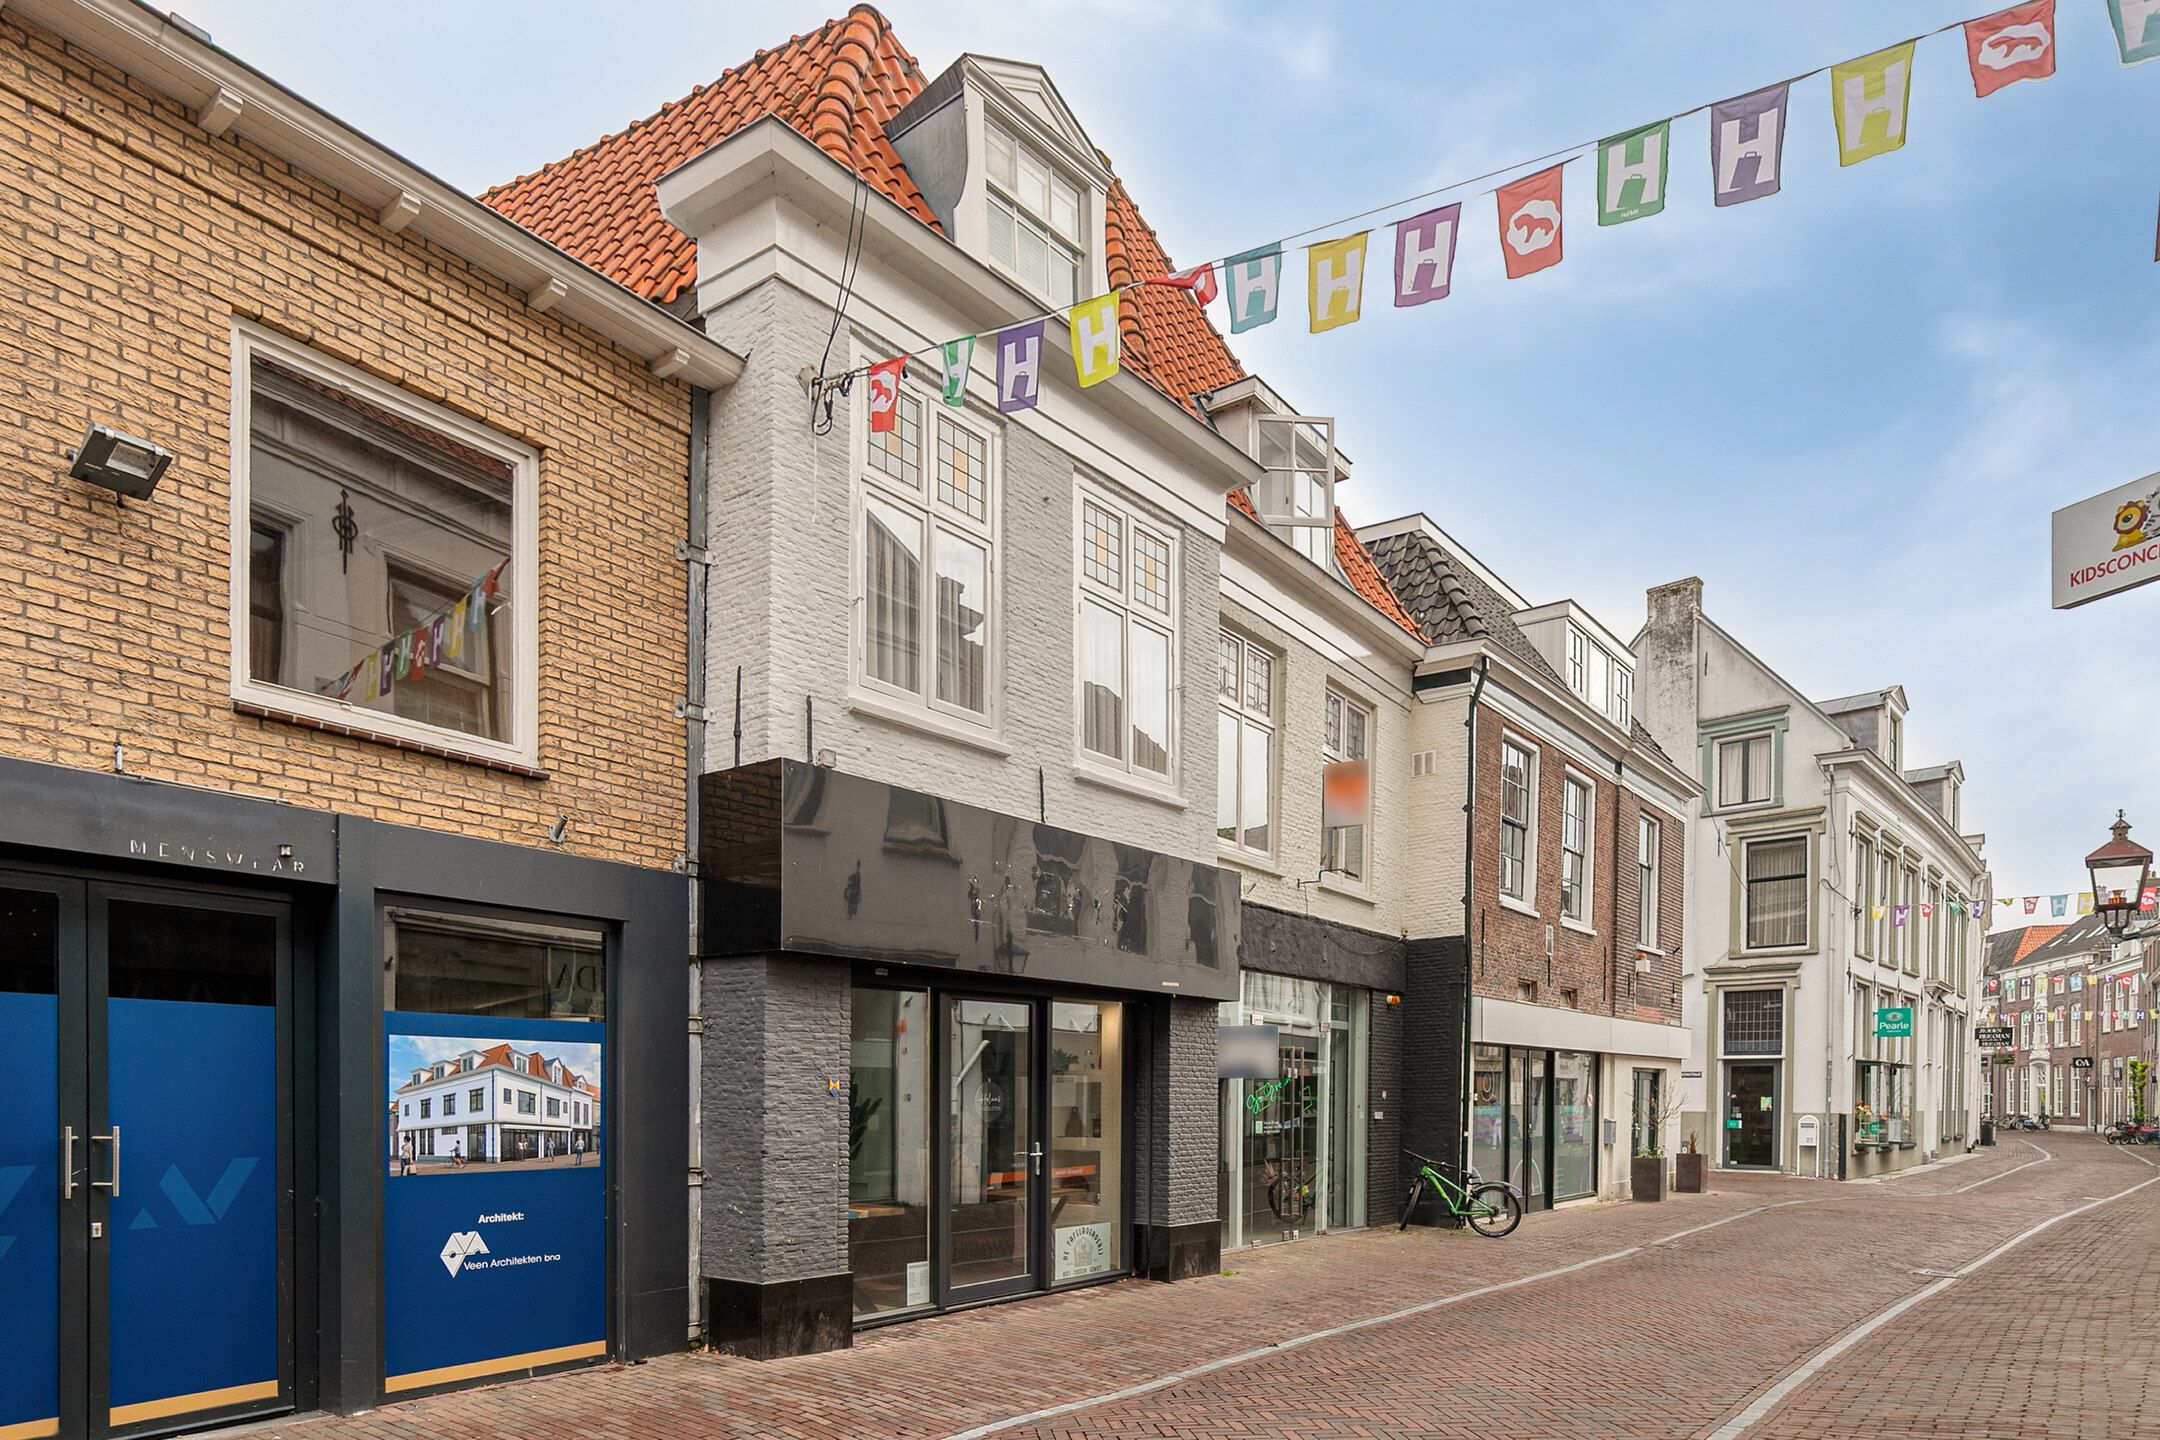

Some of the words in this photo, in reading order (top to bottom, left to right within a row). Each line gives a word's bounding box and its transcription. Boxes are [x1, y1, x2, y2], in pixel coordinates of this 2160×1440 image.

[1843, 59, 1906, 152] H
[1605, 131, 1662, 213] H
[1718, 107, 1779, 194] H
[1234, 254, 1276, 323] H
[1317, 247, 1362, 321] H
[1401, 220, 1452, 296] H
[1003, 336, 1039, 403] H
[1077, 304, 1115, 376] H
[1879, 1021, 1909, 1030] Pearle
[478, 1212, 525, 1224] Architekt:
[463, 1261, 489, 1271] Veen
[490, 1256, 542, 1268] Architekten
[544, 1253, 561, 1262] bna
